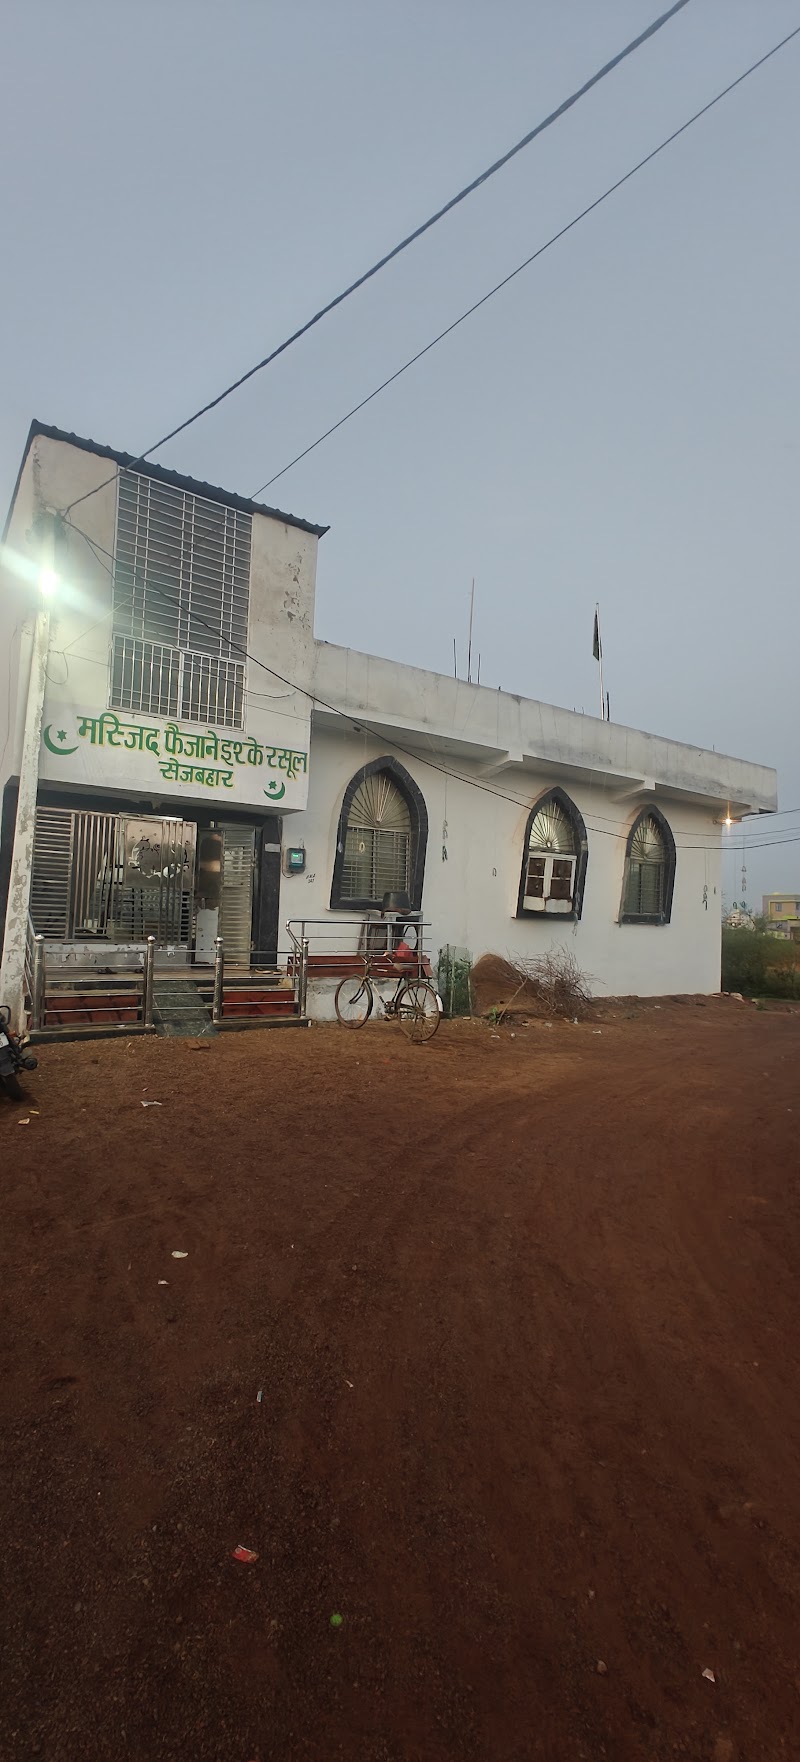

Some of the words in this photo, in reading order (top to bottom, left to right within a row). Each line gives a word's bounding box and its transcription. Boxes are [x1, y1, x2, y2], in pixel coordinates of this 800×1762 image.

[76, 712, 161, 757] मस्जिद
[163, 722, 221, 761] फैजाने
[265, 745, 309, 780] रसूल
[158, 757, 234, 788] सेजबहार
